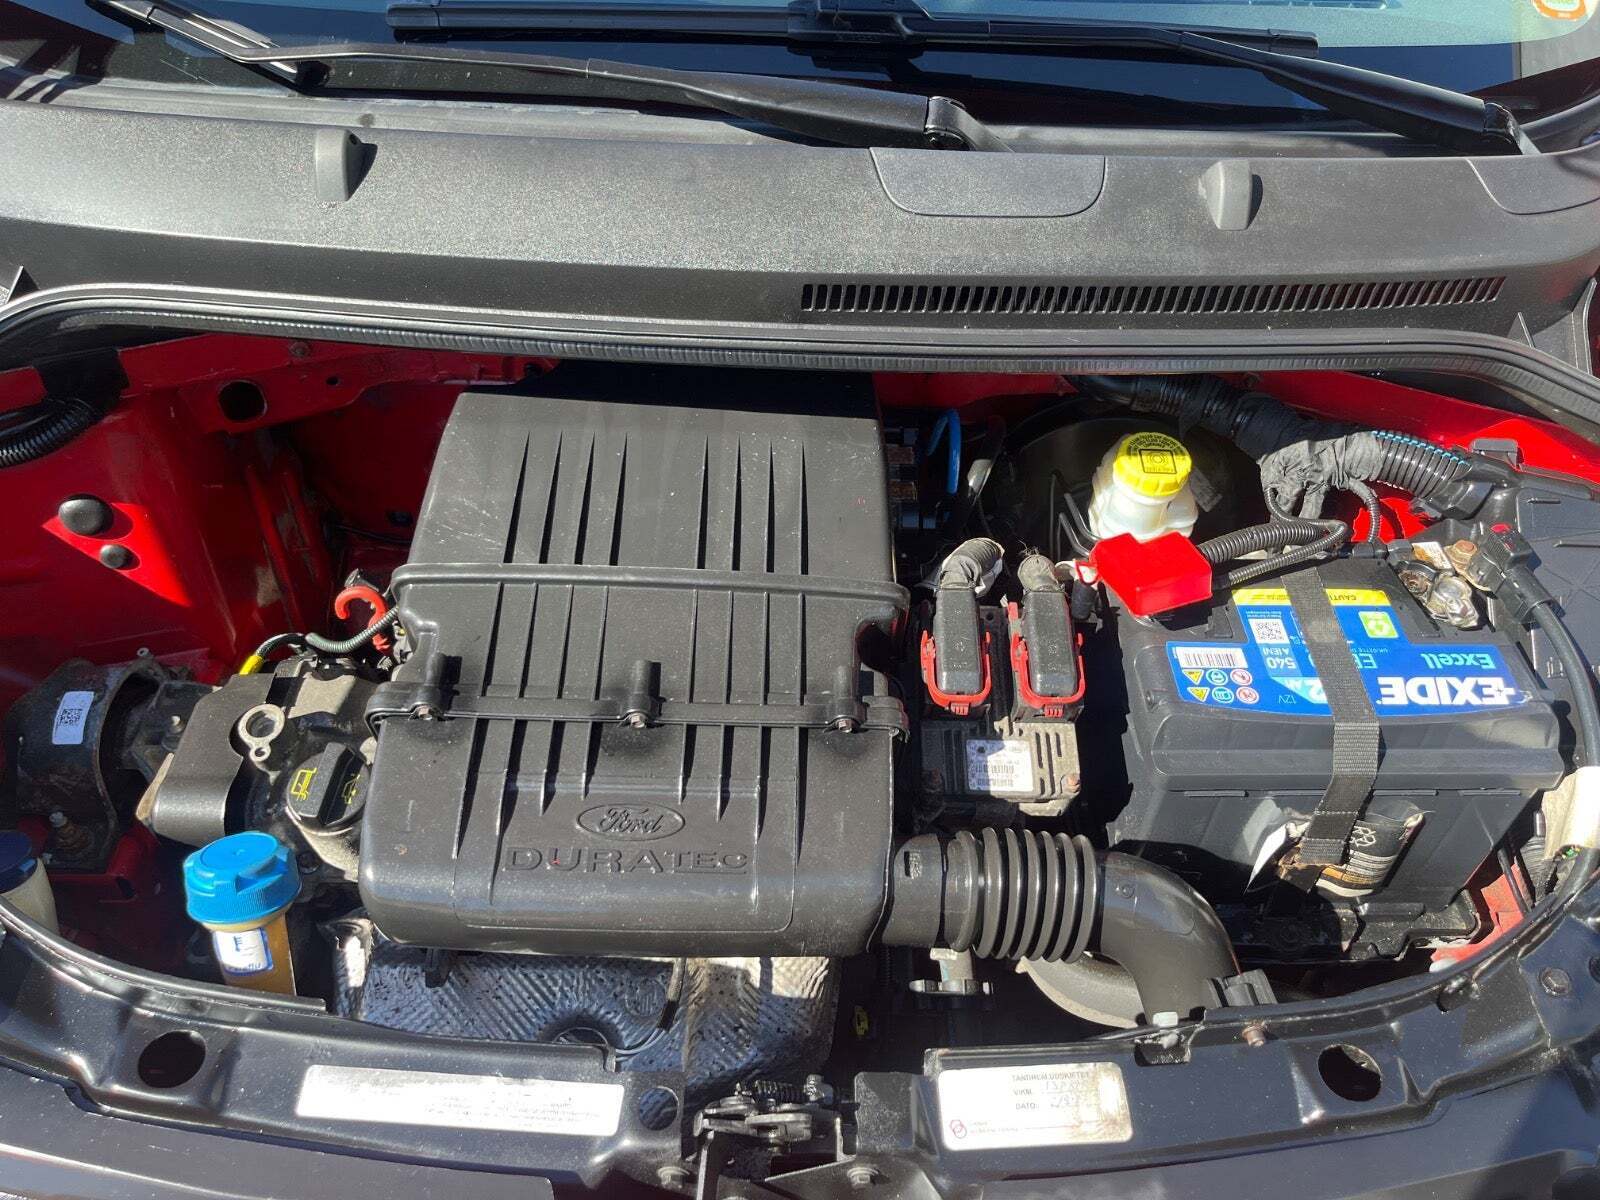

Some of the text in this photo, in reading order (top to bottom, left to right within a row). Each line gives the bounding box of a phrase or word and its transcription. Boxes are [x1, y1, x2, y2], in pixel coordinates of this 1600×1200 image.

[1266, 656, 1297, 670] 540
[1421, 652, 1496, 670] Excell
[1378, 676, 1508, 706] EXIDE
[600, 806, 665, 834] Ford
[503, 847, 748, 874] DURATEC
